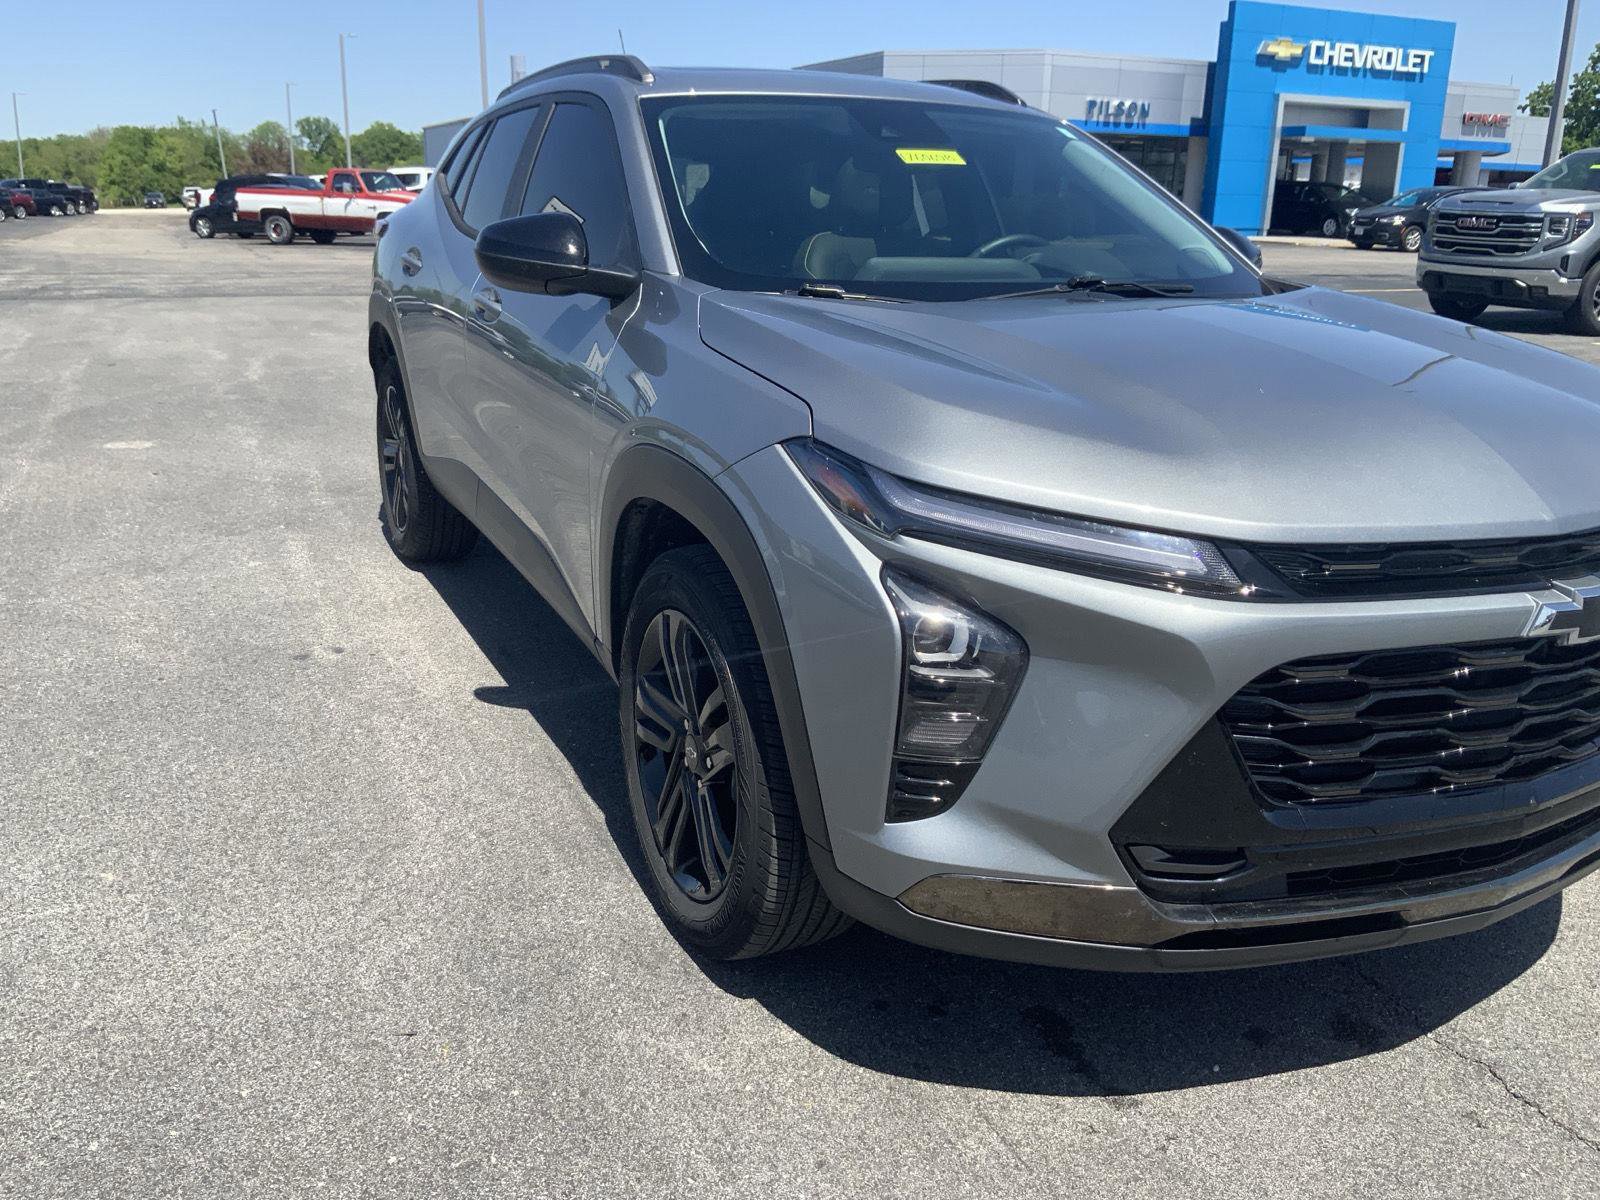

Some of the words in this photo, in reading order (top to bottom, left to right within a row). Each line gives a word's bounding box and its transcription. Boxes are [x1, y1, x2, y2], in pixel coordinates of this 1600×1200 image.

[1308, 40, 1435, 74] CHEVROLET
[1086, 99, 1151, 119] PILSON
[1456, 216, 1497, 229] GMC
